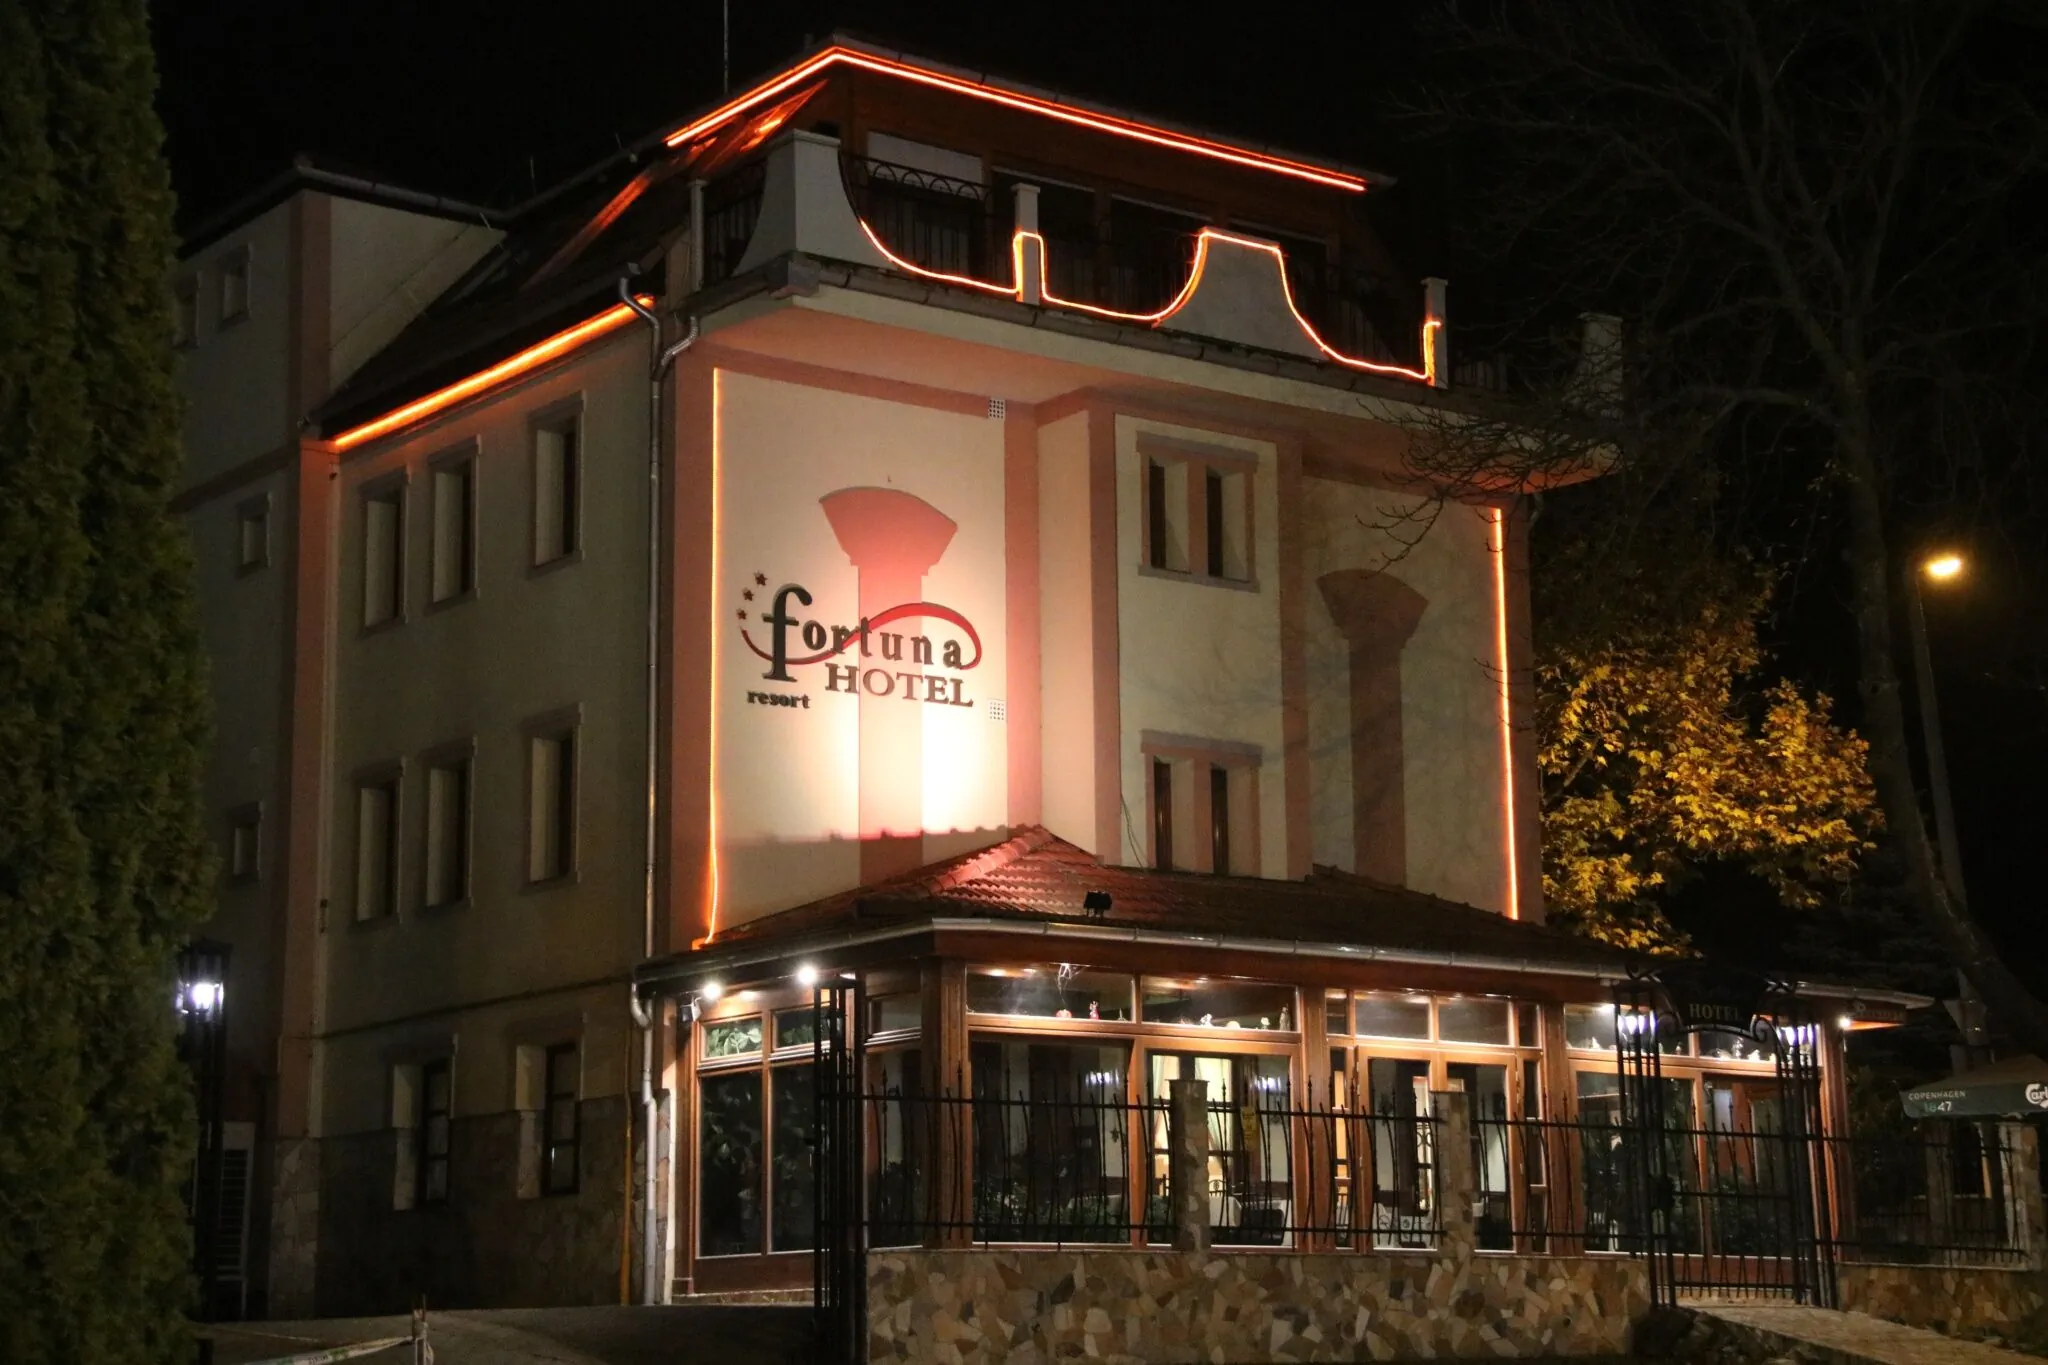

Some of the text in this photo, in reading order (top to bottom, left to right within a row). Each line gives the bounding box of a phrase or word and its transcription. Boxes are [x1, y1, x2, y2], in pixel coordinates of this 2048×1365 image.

[762, 583, 962, 682] fortuna
[825, 662, 974, 707] HOTEL
[747, 690, 810, 709] resort
[1688, 1003, 1742, 1021] HOTEL
[1908, 1090, 1966, 1101] COPENHAGEN
